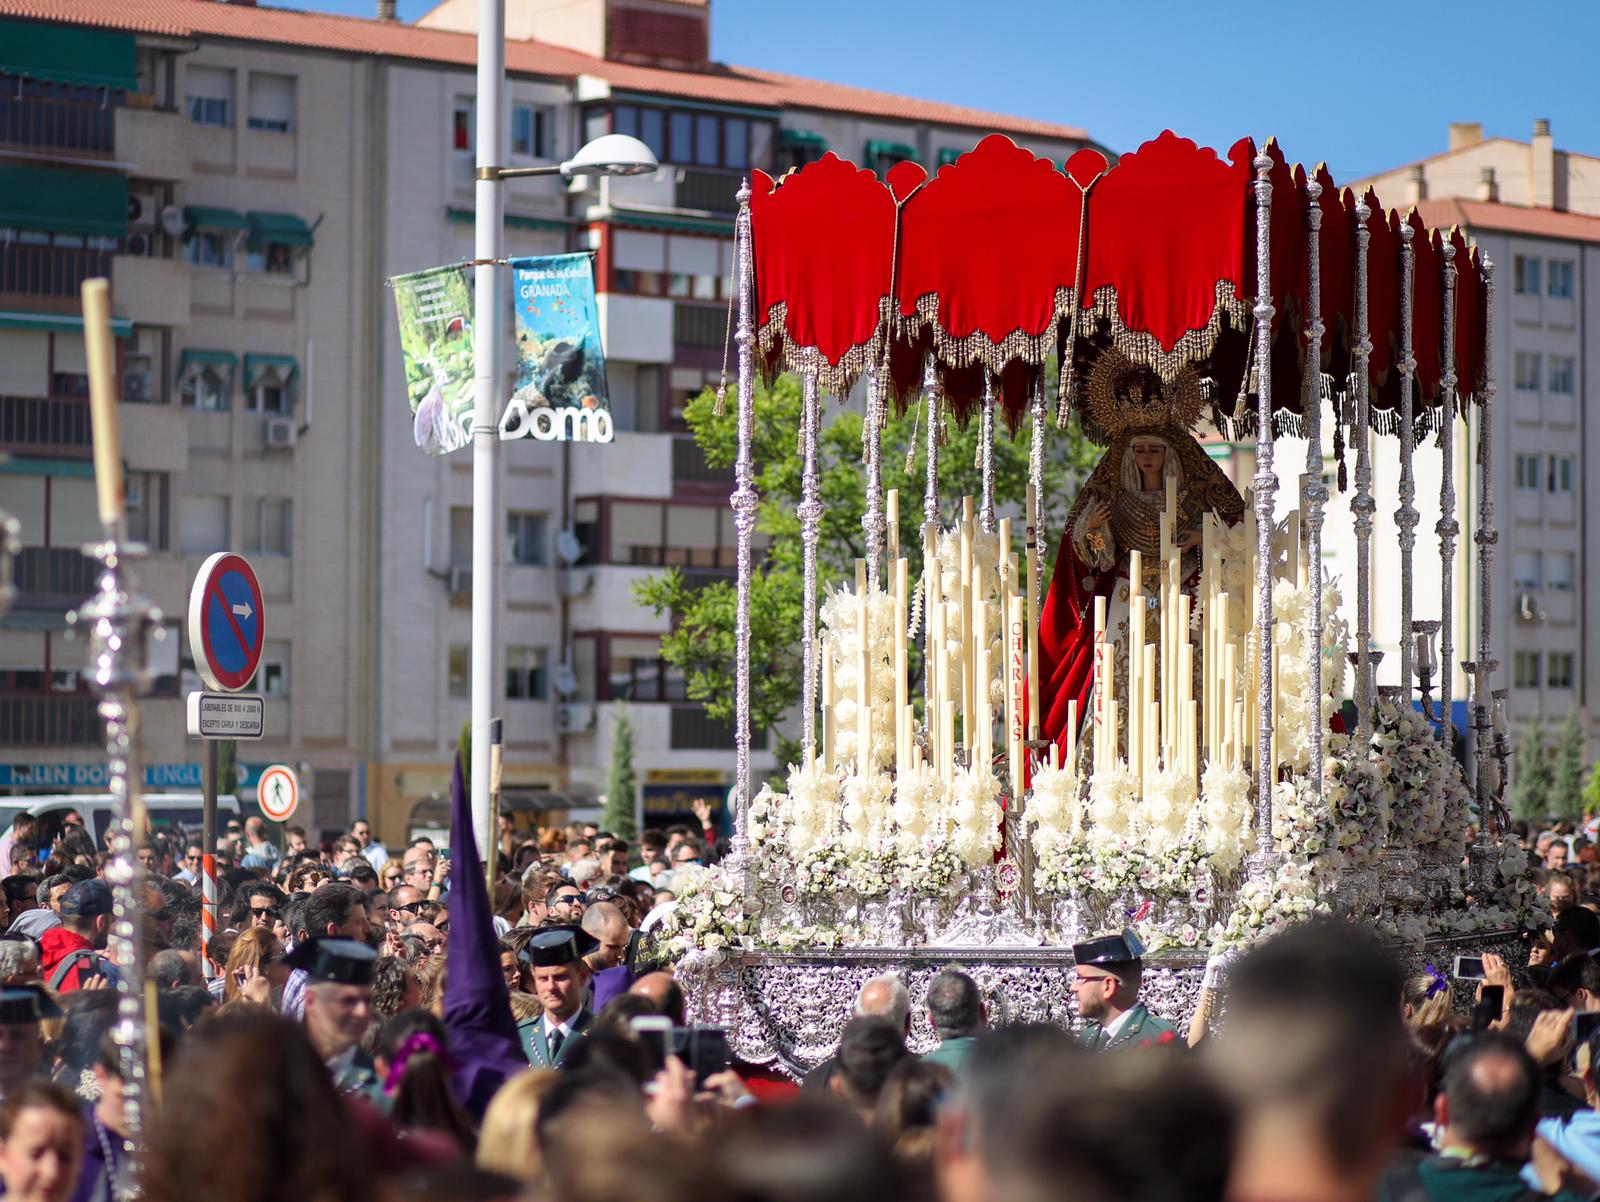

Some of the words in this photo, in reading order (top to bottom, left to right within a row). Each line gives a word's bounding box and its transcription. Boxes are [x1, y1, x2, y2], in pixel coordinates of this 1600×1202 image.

[520, 284, 572, 299] GRANADA
[499, 399, 614, 443] Domo
[1011, 622, 1022, 741] CHARITAS
[202, 703, 227, 712] LABORABLES
[227, 703, 233, 712] DE
[202, 719, 220, 728] EXCEPTO
[221, 720, 234, 729] CARGA
[239, 720, 260, 730] DESCARGA
